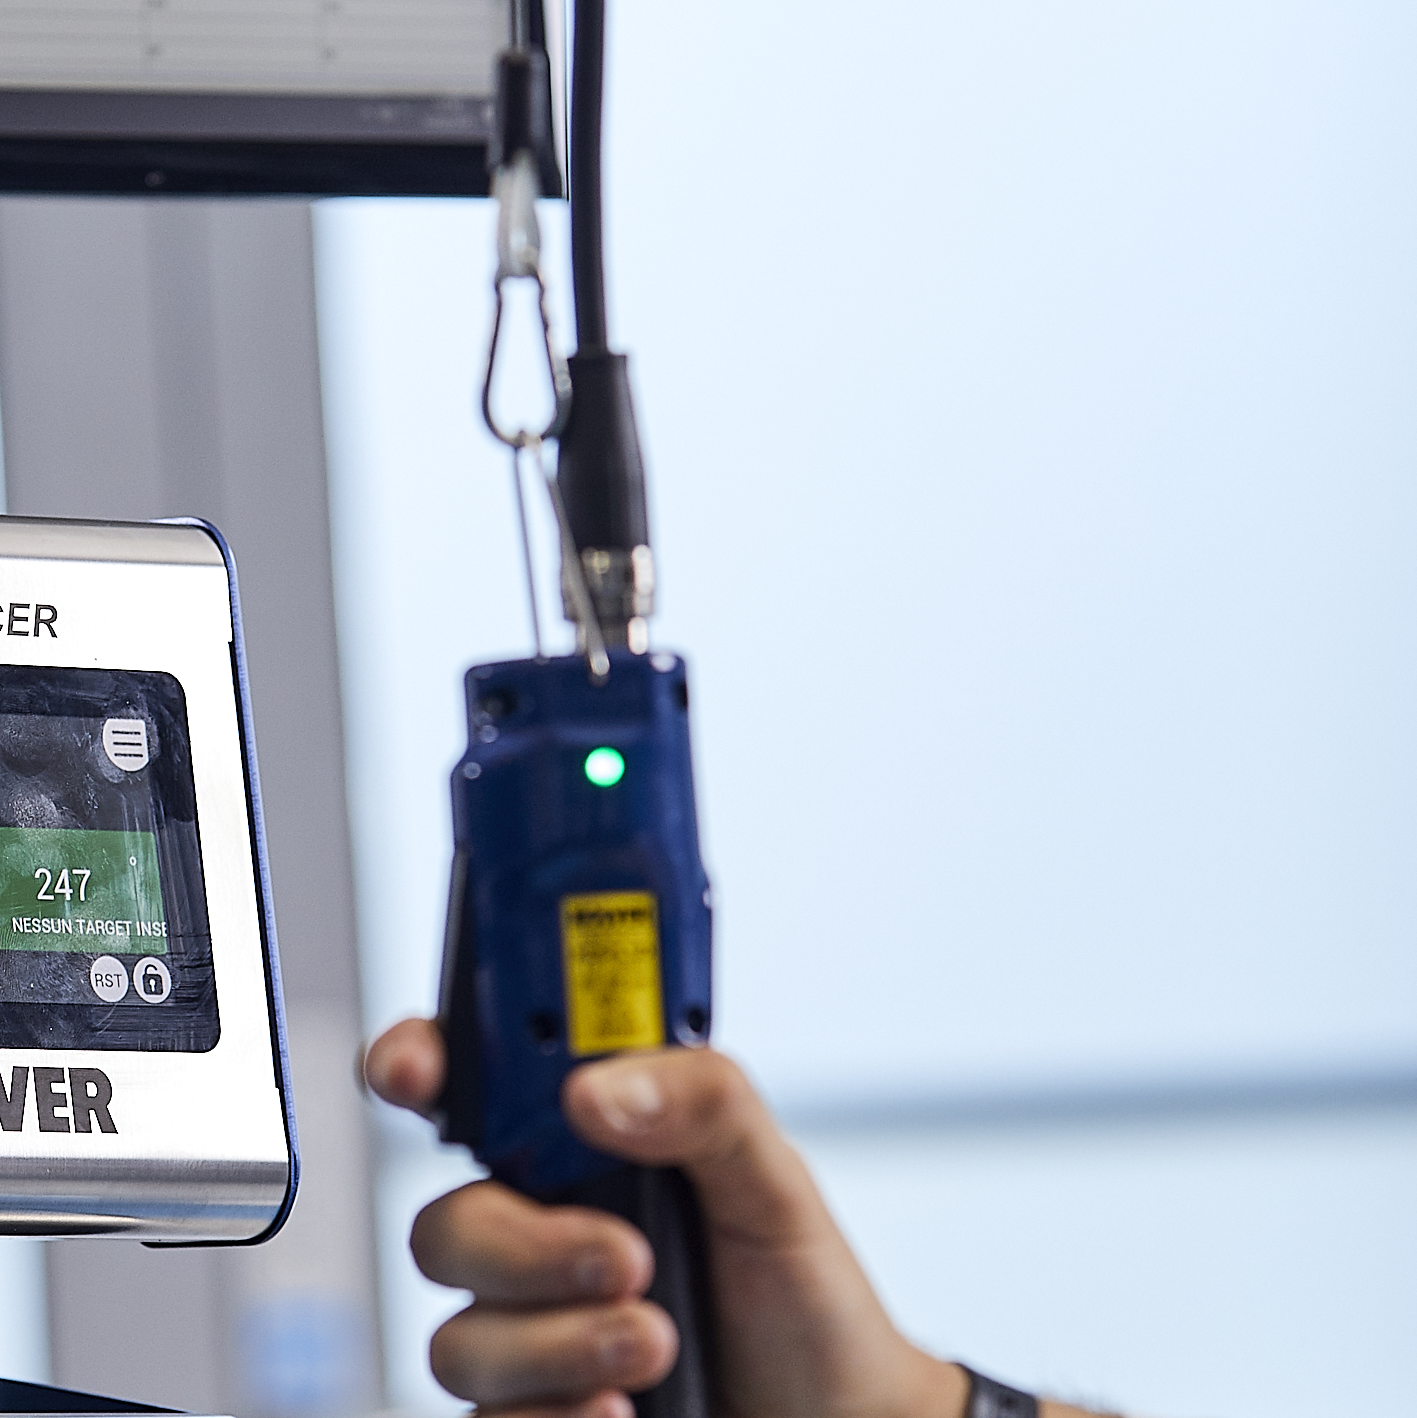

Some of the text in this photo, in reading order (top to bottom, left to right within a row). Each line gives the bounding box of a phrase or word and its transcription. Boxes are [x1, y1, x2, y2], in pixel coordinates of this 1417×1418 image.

[34, 867, 92, 902] 247
[12, 916, 72, 935] NESSUN
[76, 918, 133, 937] TARGET
[95, 973, 123, 988] RST
